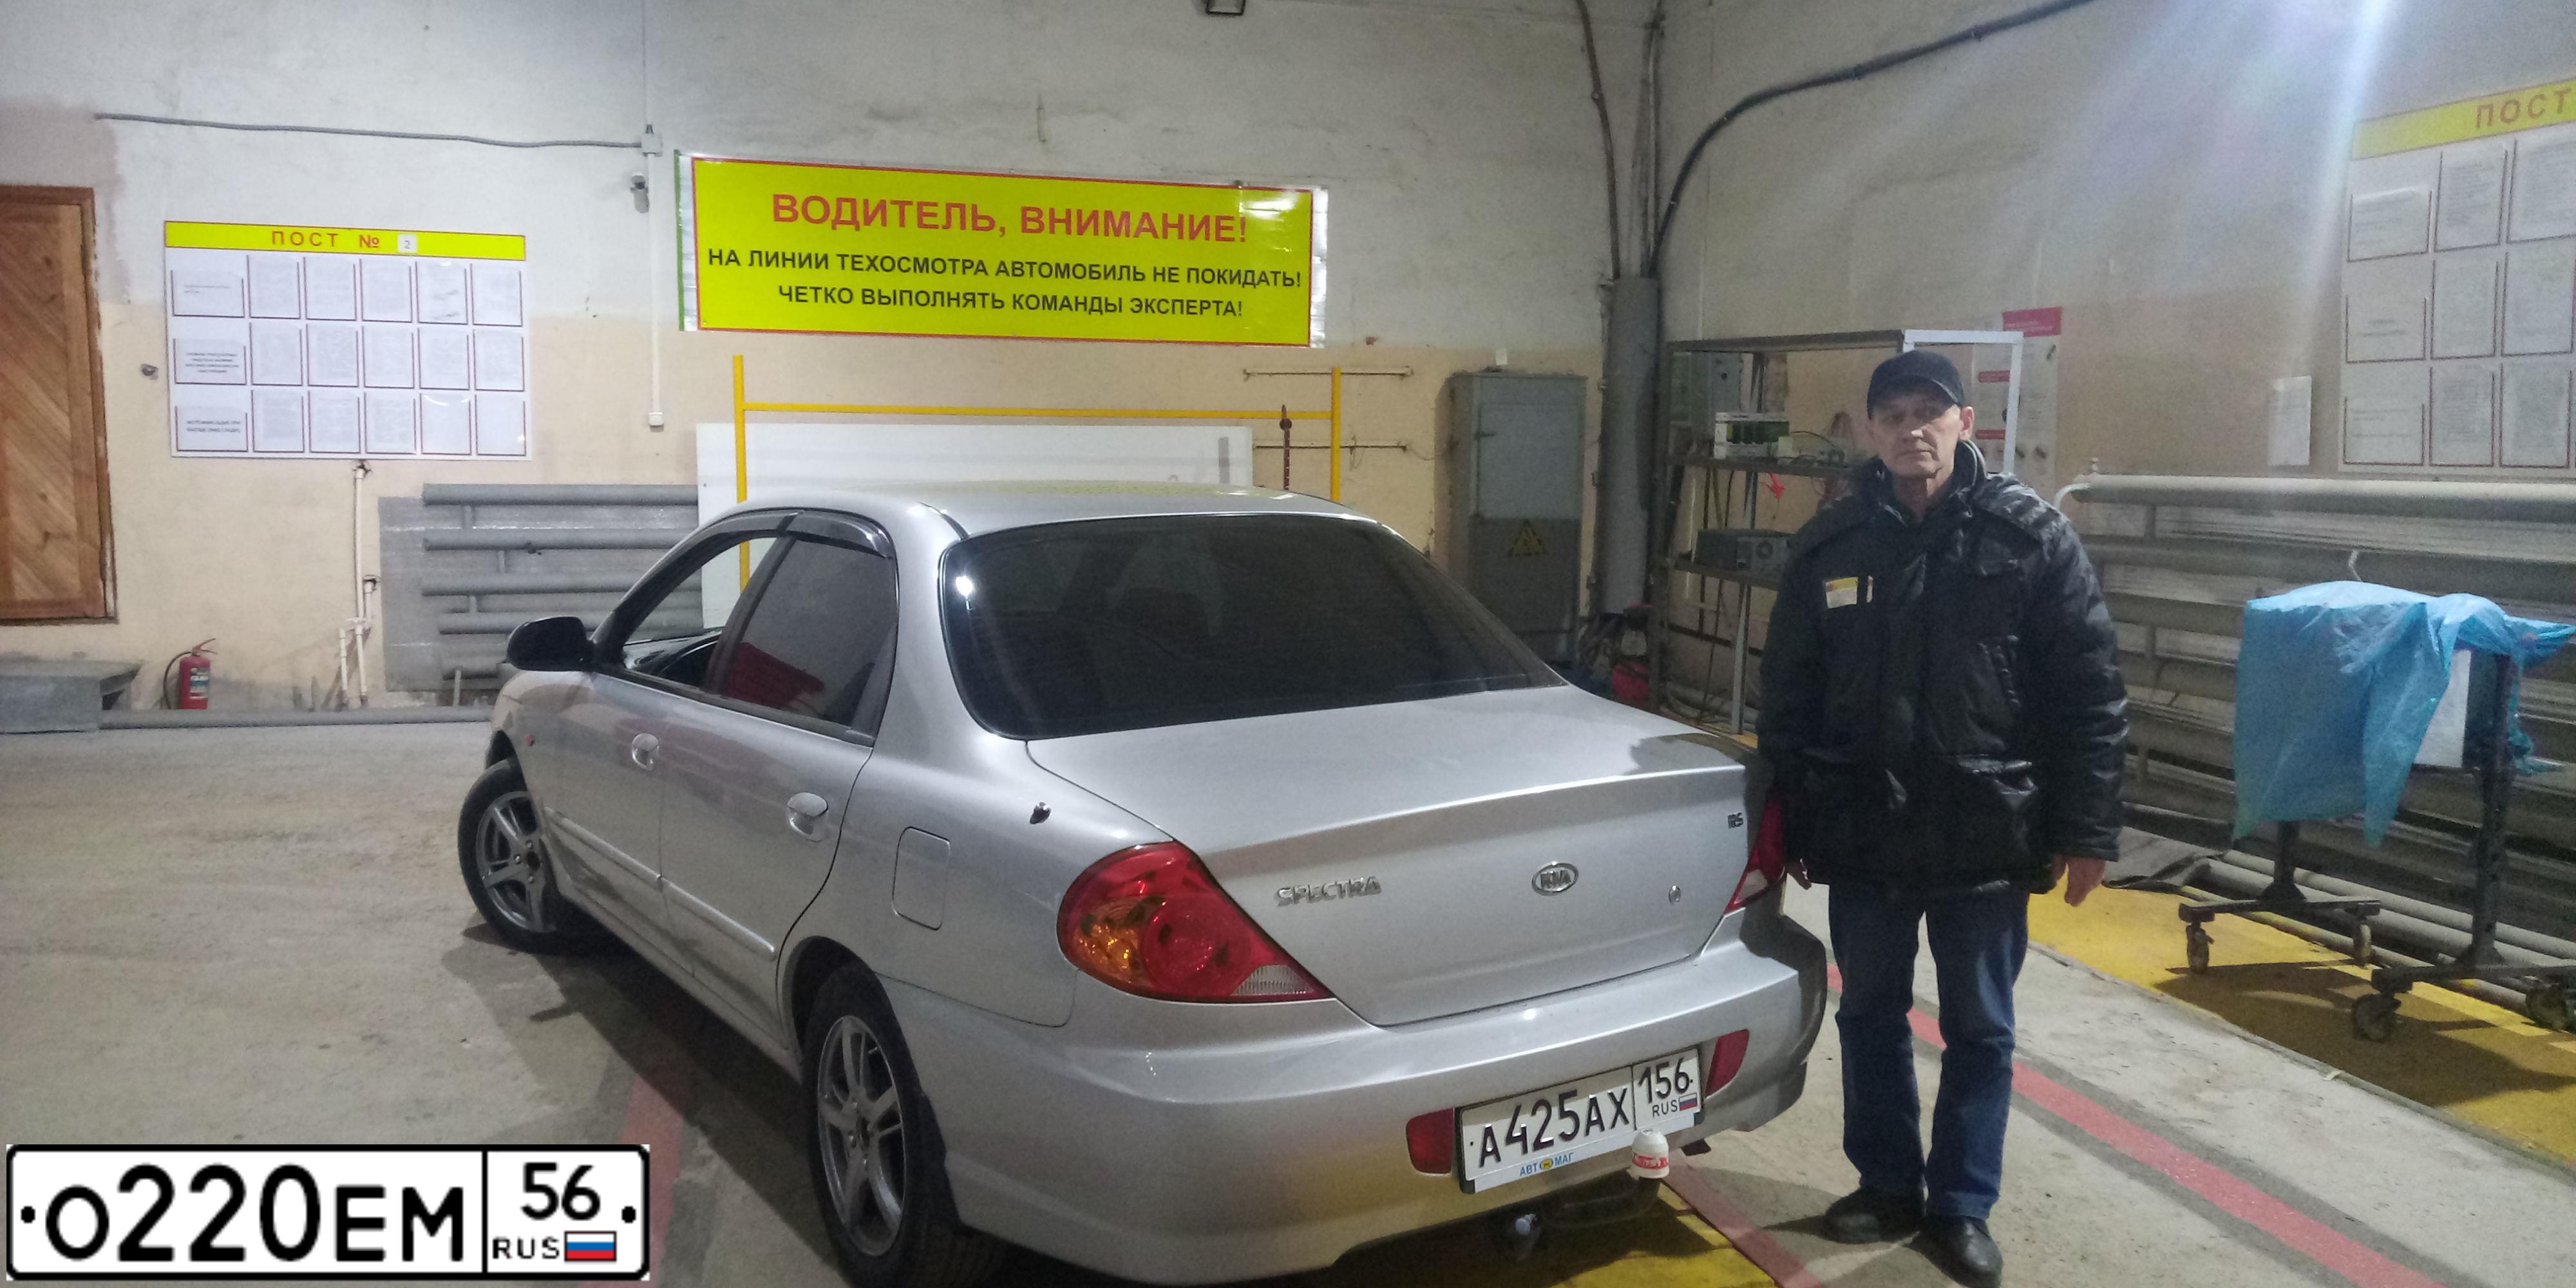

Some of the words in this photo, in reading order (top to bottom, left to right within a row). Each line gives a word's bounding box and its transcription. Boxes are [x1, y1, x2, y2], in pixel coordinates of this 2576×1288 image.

[2477, 88, 2572, 128] ПОСТ
[773, 194, 1005, 237] ВОДИТЕЛЬ,
[1021, 207, 1247, 242] ВНИМАНИЕ!
[272, 231, 338, 247] ПОСТ
[359, 234, 379, 249] №
[404, 240, 411, 249] 2
[708, 249, 741, 267] НА
[748, 250, 829, 270] ЛИНИИ
[837, 253, 988, 276] ТЕХОСМОТРА
[996, 260, 1146, 281] АВТОМОБИЛЬ
[1153, 267, 1181, 285] НЕ
[1188, 268, 1301, 287] ПОКИДАТЬ!
[779, 286, 853, 304] ЧЕТКО
[862, 289, 1005, 309] ВЫПОЛНЯТЬ
[1012, 294, 1123, 316] КОМАНДЫ
[1130, 298, 1242, 317] ЭКСПЕРТА!
[1276, 876, 1382, 907] SPECTRA
[1638, 1057, 1689, 1103] 156
[1652, 1099, 1679, 1118] RUS
